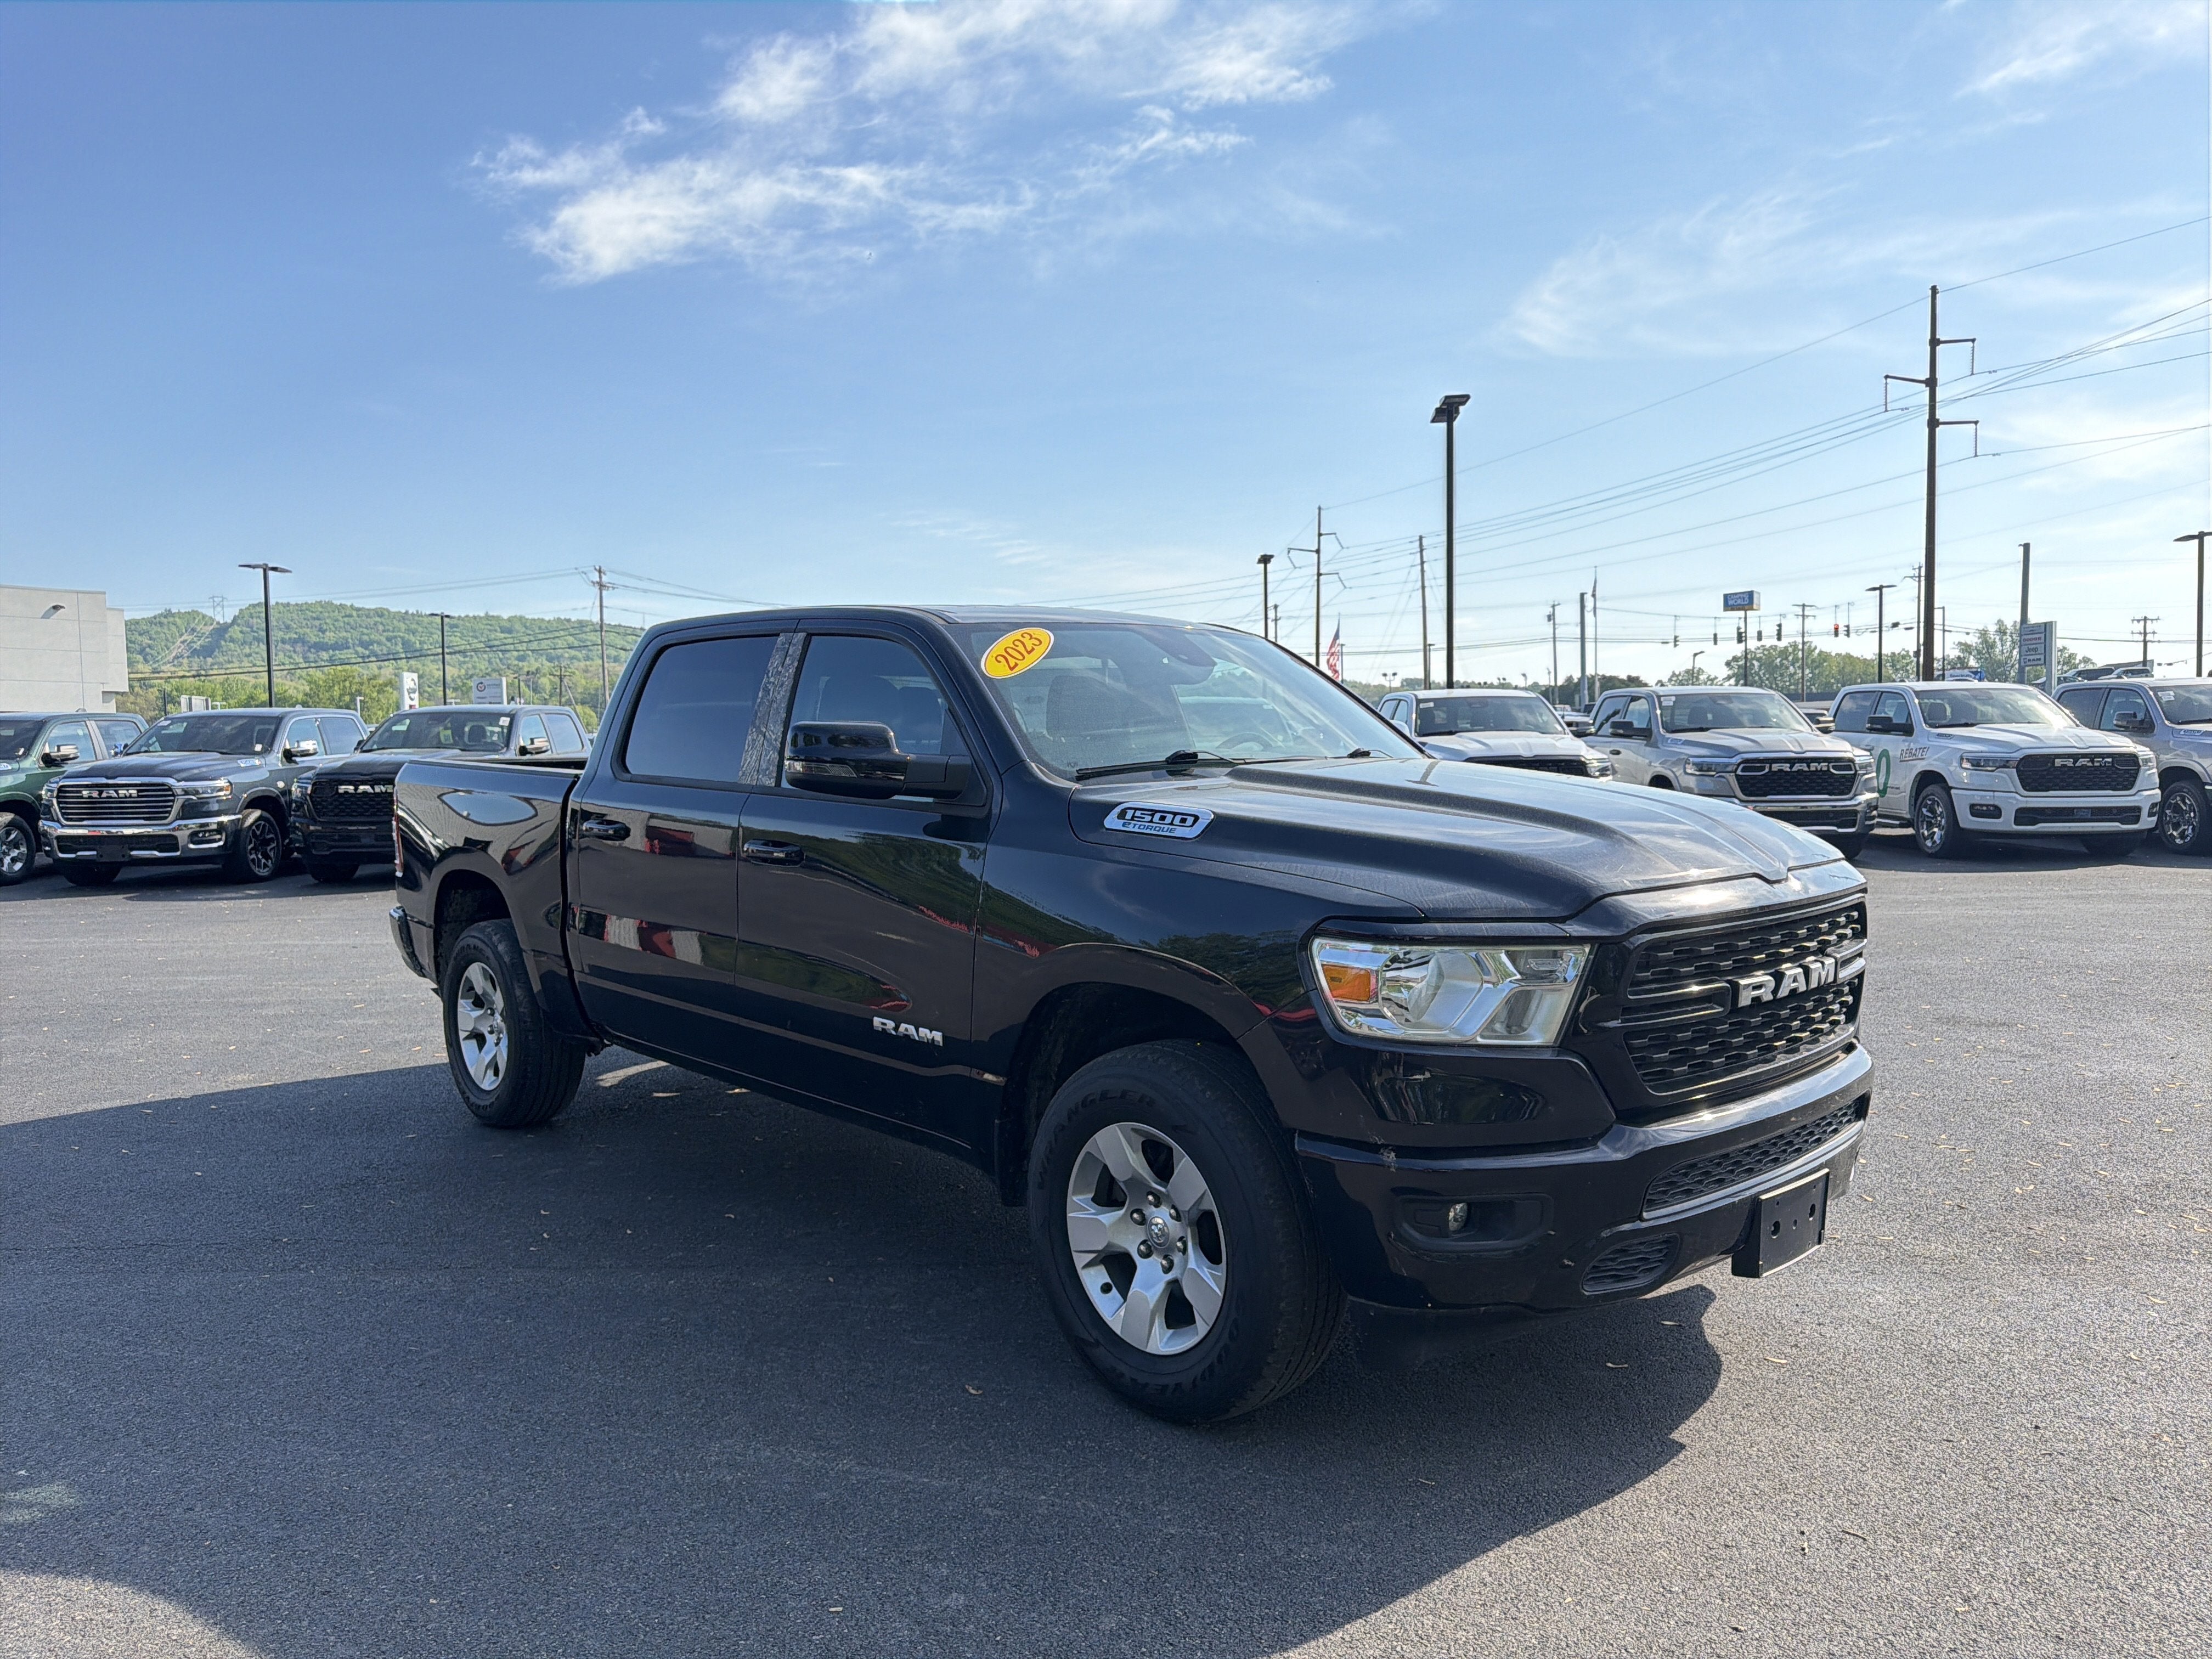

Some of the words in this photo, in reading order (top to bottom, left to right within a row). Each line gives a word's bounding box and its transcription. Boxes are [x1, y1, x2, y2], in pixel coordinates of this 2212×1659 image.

[1728, 597, 1749, 606] WORLD
[995, 631, 1042, 672] 2023
[1899, 746, 1930, 760] REBATE!
[1771, 763, 1829, 772] RAM
[2055, 758, 2112, 767] RAM
[82, 790, 138, 798] RAM
[338, 785, 393, 793] RAM
[1125, 809, 1195, 827] 1500
[1737, 956, 1835, 1008] RAM
[873, 1016, 943, 1047] RAM
